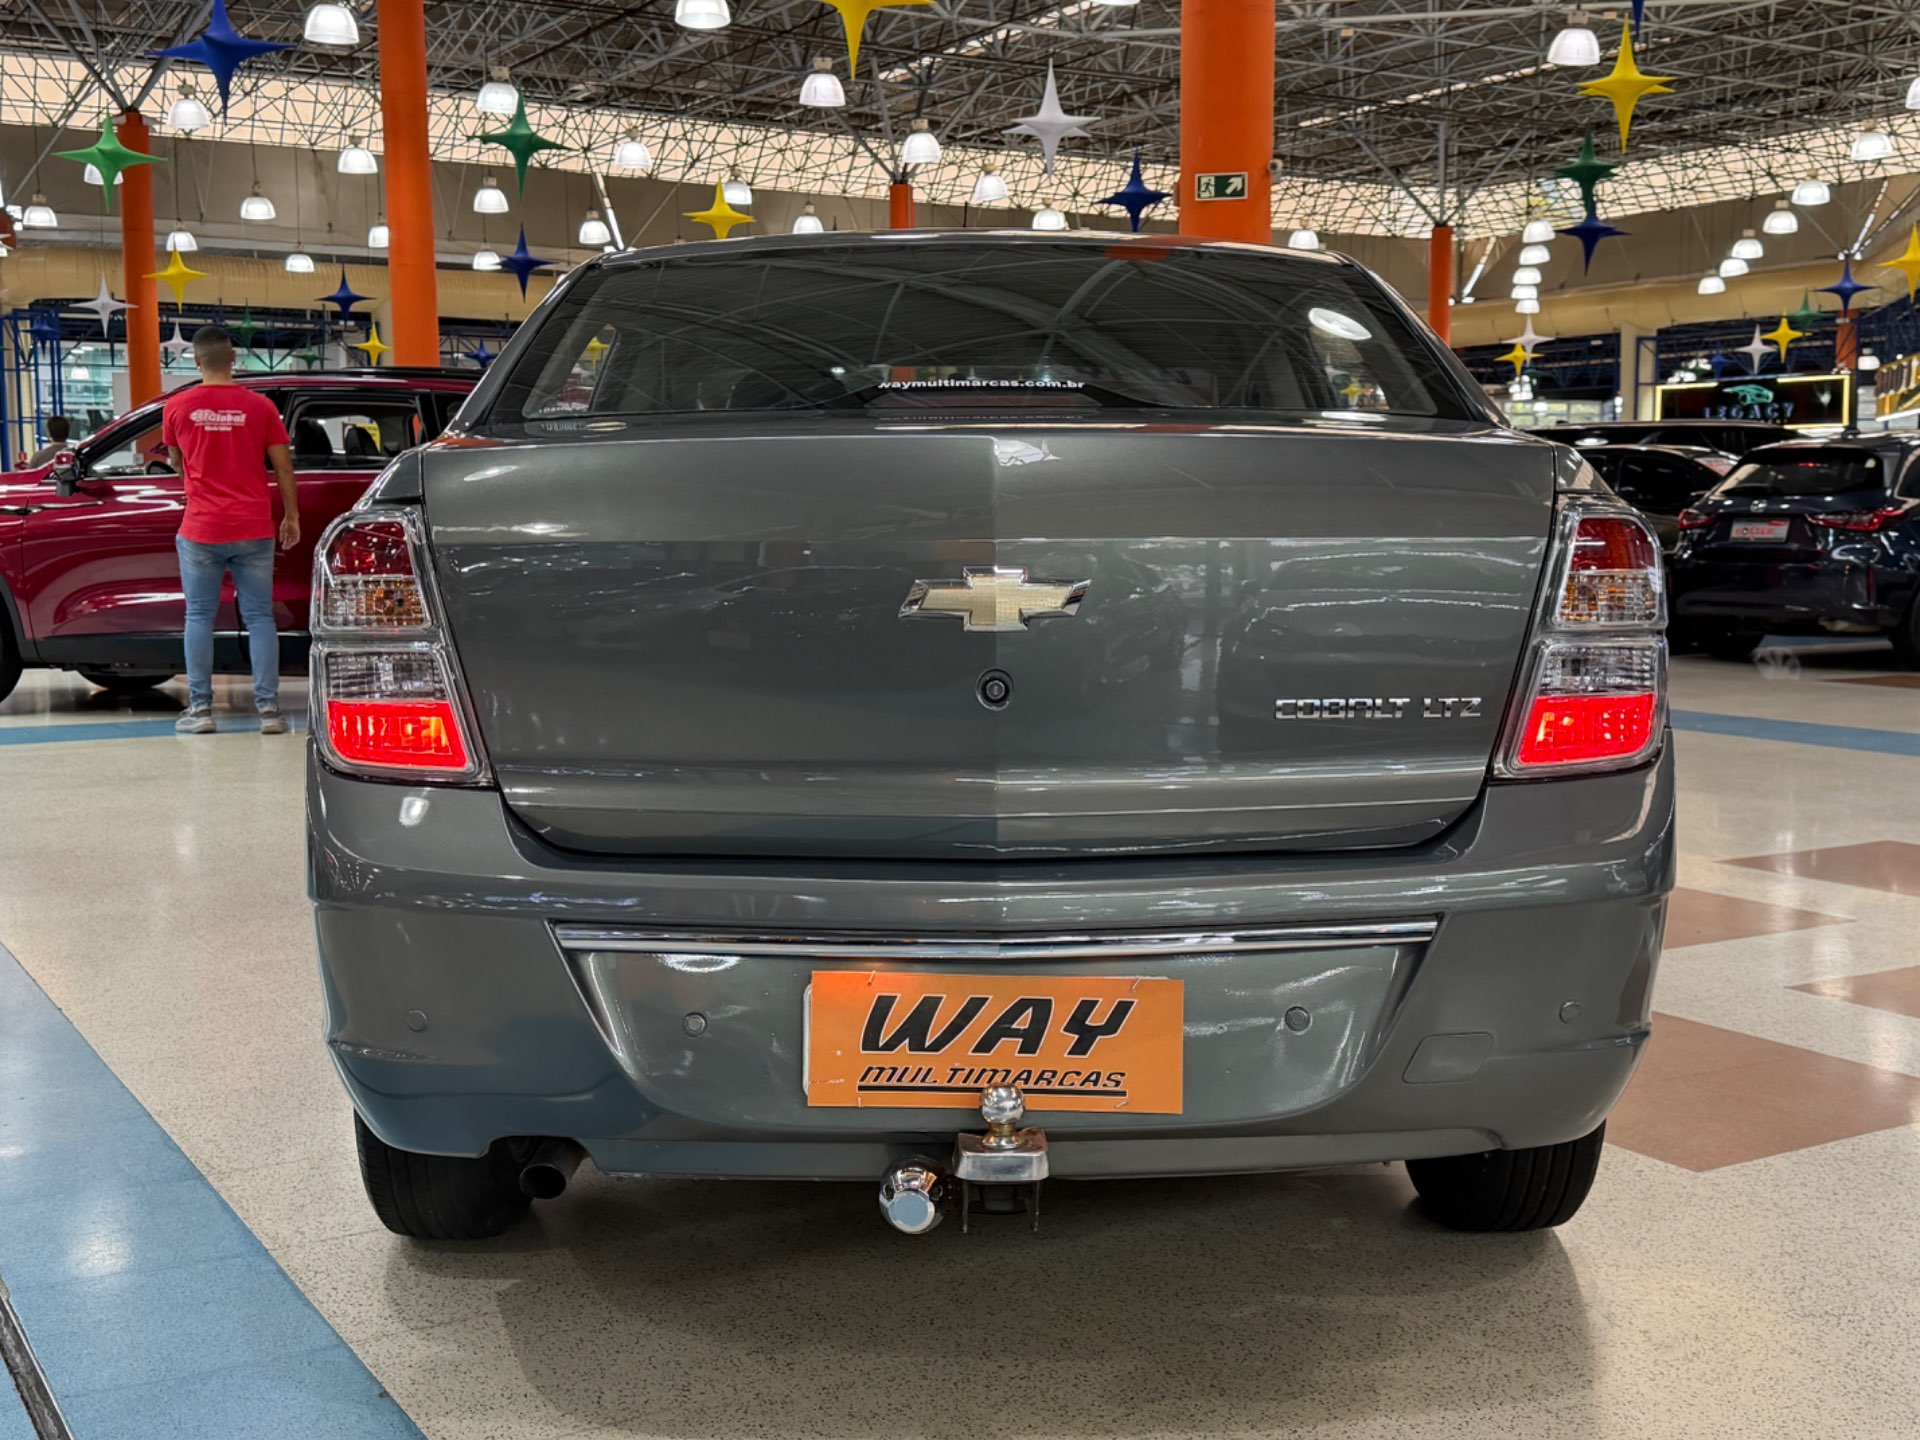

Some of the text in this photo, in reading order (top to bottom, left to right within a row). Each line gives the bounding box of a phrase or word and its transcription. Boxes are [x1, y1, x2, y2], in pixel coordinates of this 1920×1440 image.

[1704, 402, 1794, 420] LEGACY
[1275, 697, 1483, 719] COBALT LTZ
[860, 994, 1138, 1058] WAY
[858, 1065, 1128, 1089] MULTIMARCAS
